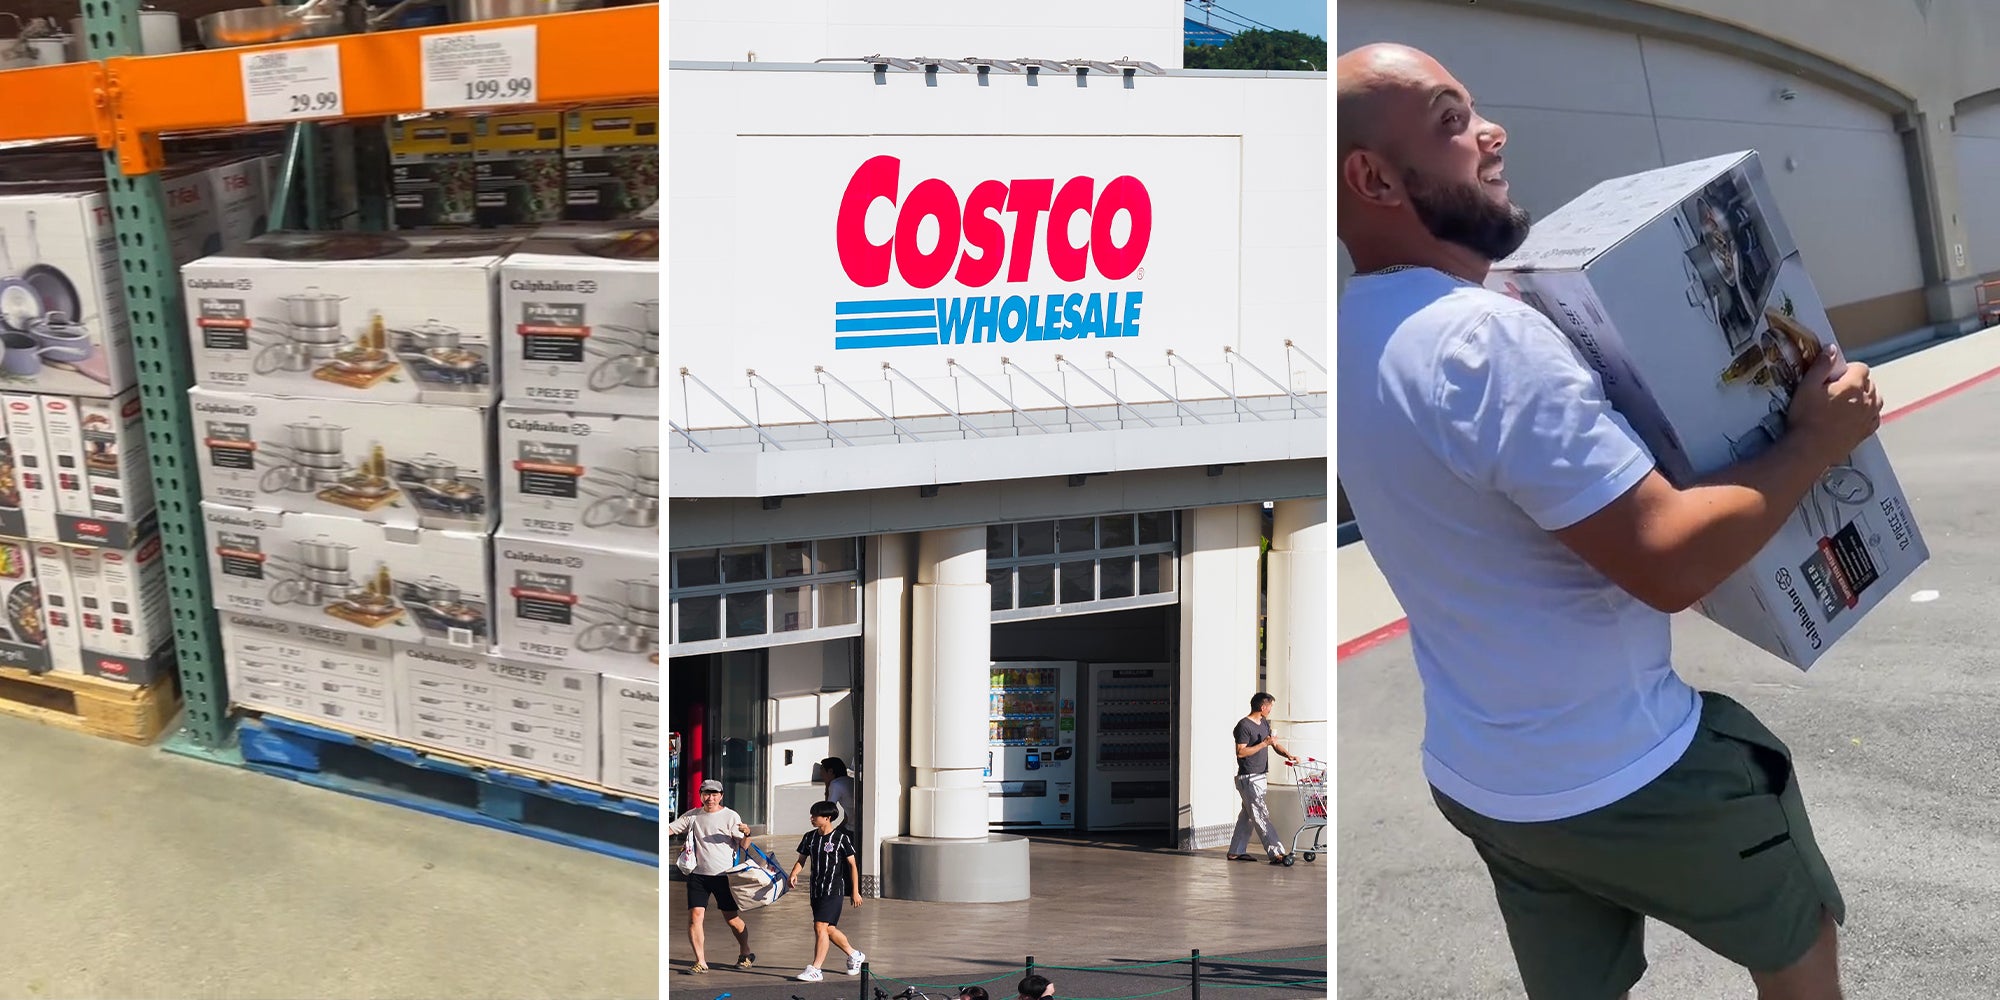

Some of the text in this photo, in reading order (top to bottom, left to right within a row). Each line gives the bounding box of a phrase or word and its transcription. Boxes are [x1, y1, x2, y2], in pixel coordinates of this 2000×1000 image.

[465, 77, 532, 100] 199.99
[290, 92, 338, 113] 29.99
[836, 155, 1152, 289] COSTCO
[510, 280, 574, 293] Calphalon
[936, 291, 1143, 345] WHOLESALE
[537, 387, 561, 398] PIECE
[563, 389, 580, 400] SET
[507, 419, 569, 433] Calphalon
[1879, 496, 1895, 517] SET
[557, 521, 574, 533] SET
[1887, 512, 1906, 541] PIECE
[1898, 536, 1910, 551] 12
[503, 550, 563, 566] Calphalon
[1807, 564, 1836, 613] PREMIER
[1788, 588, 1823, 650] Calphalon
[407, 649, 459, 667] Calphalon
[553, 646, 569, 657] SET
[487, 662, 498, 673] 12
[499, 664, 527, 679] PIECE
[529, 669, 548, 682] SET
